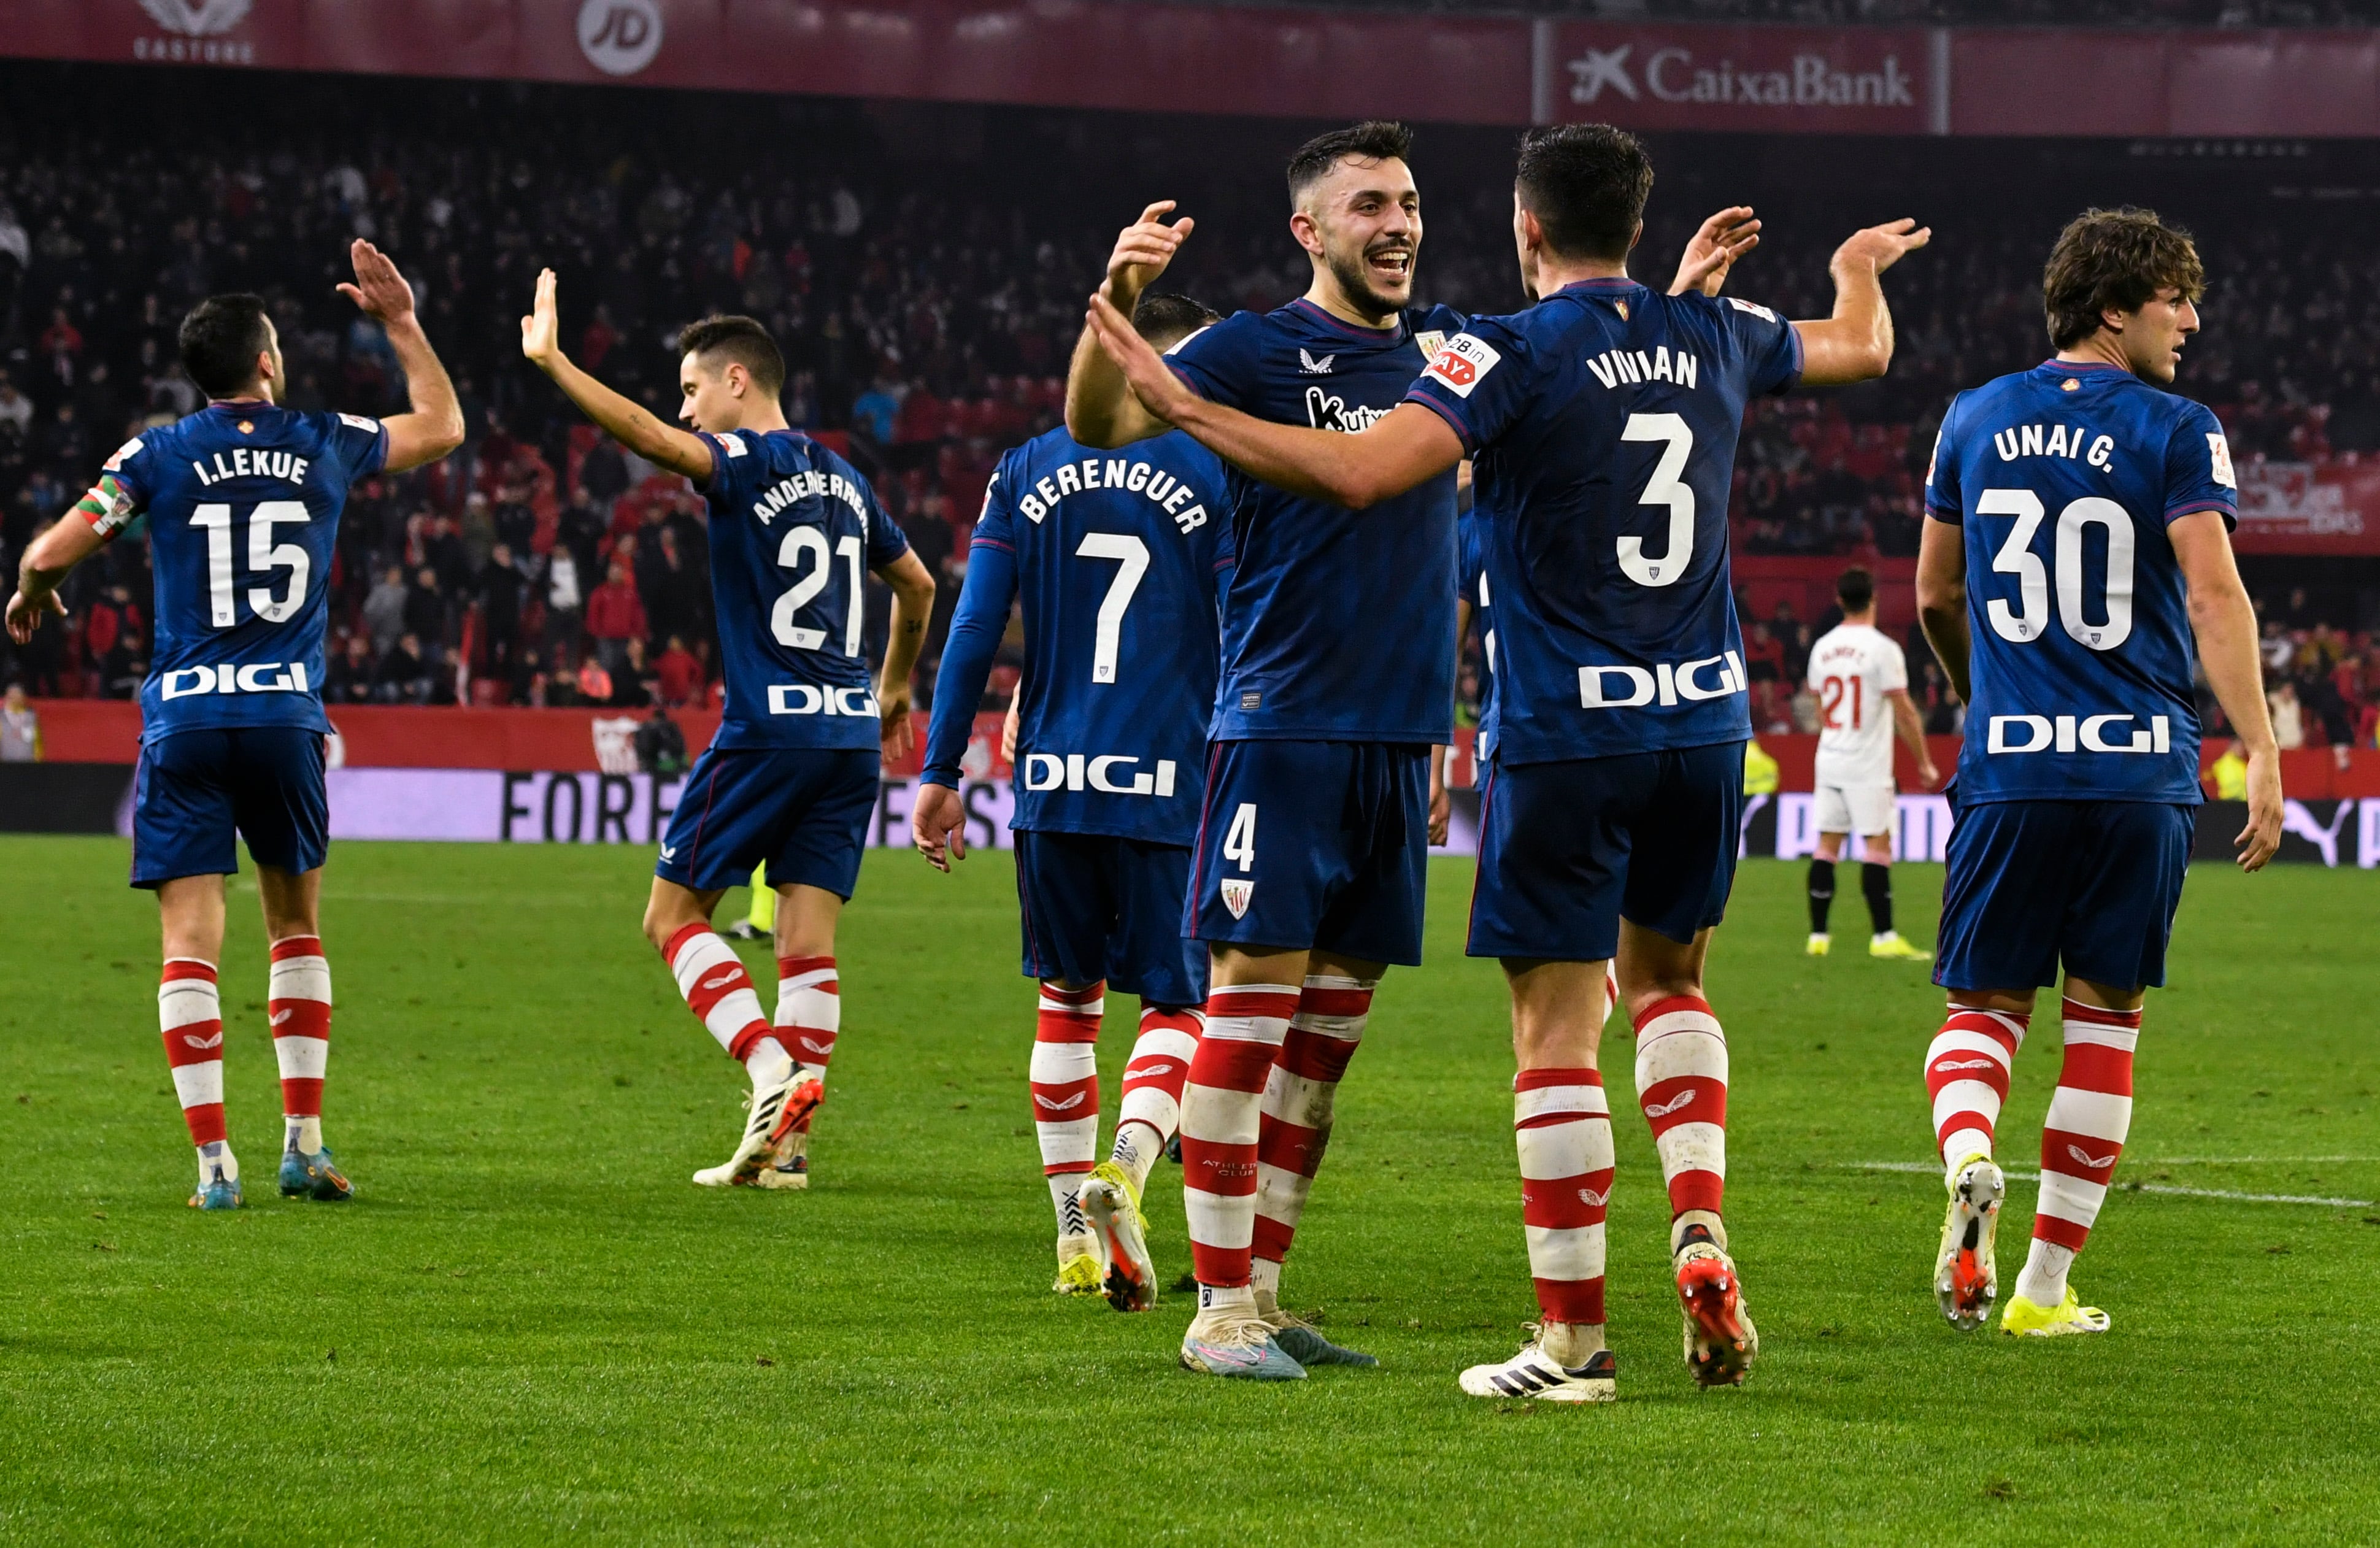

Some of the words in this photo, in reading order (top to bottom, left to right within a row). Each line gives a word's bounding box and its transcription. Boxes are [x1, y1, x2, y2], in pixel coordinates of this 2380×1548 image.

[590, 8, 649, 50] JD
[1645, 47, 1913, 106] CaixaBank
[1586, 345, 1696, 390] VIVIAN
[193, 449, 309, 486] I.LEKUE
[1993, 424, 2085, 461] UNAI
[2087, 434, 2114, 473] G.
[1019, 459, 1207, 534] BERENGUER
[1616, 413, 1695, 587] 3
[188, 501, 311, 627] 15
[771, 525, 863, 658] 21
[1975, 488, 2135, 650] 30
[1075, 533, 1150, 684] 7
[162, 662, 308, 701] DIGI
[1578, 650, 1747, 709] DIGI
[1823, 675, 1862, 730] 21
[1987, 714, 2170, 754] DIGI
[1025, 753, 1176, 797] DIGI
[1223, 803, 1257, 872] 4
